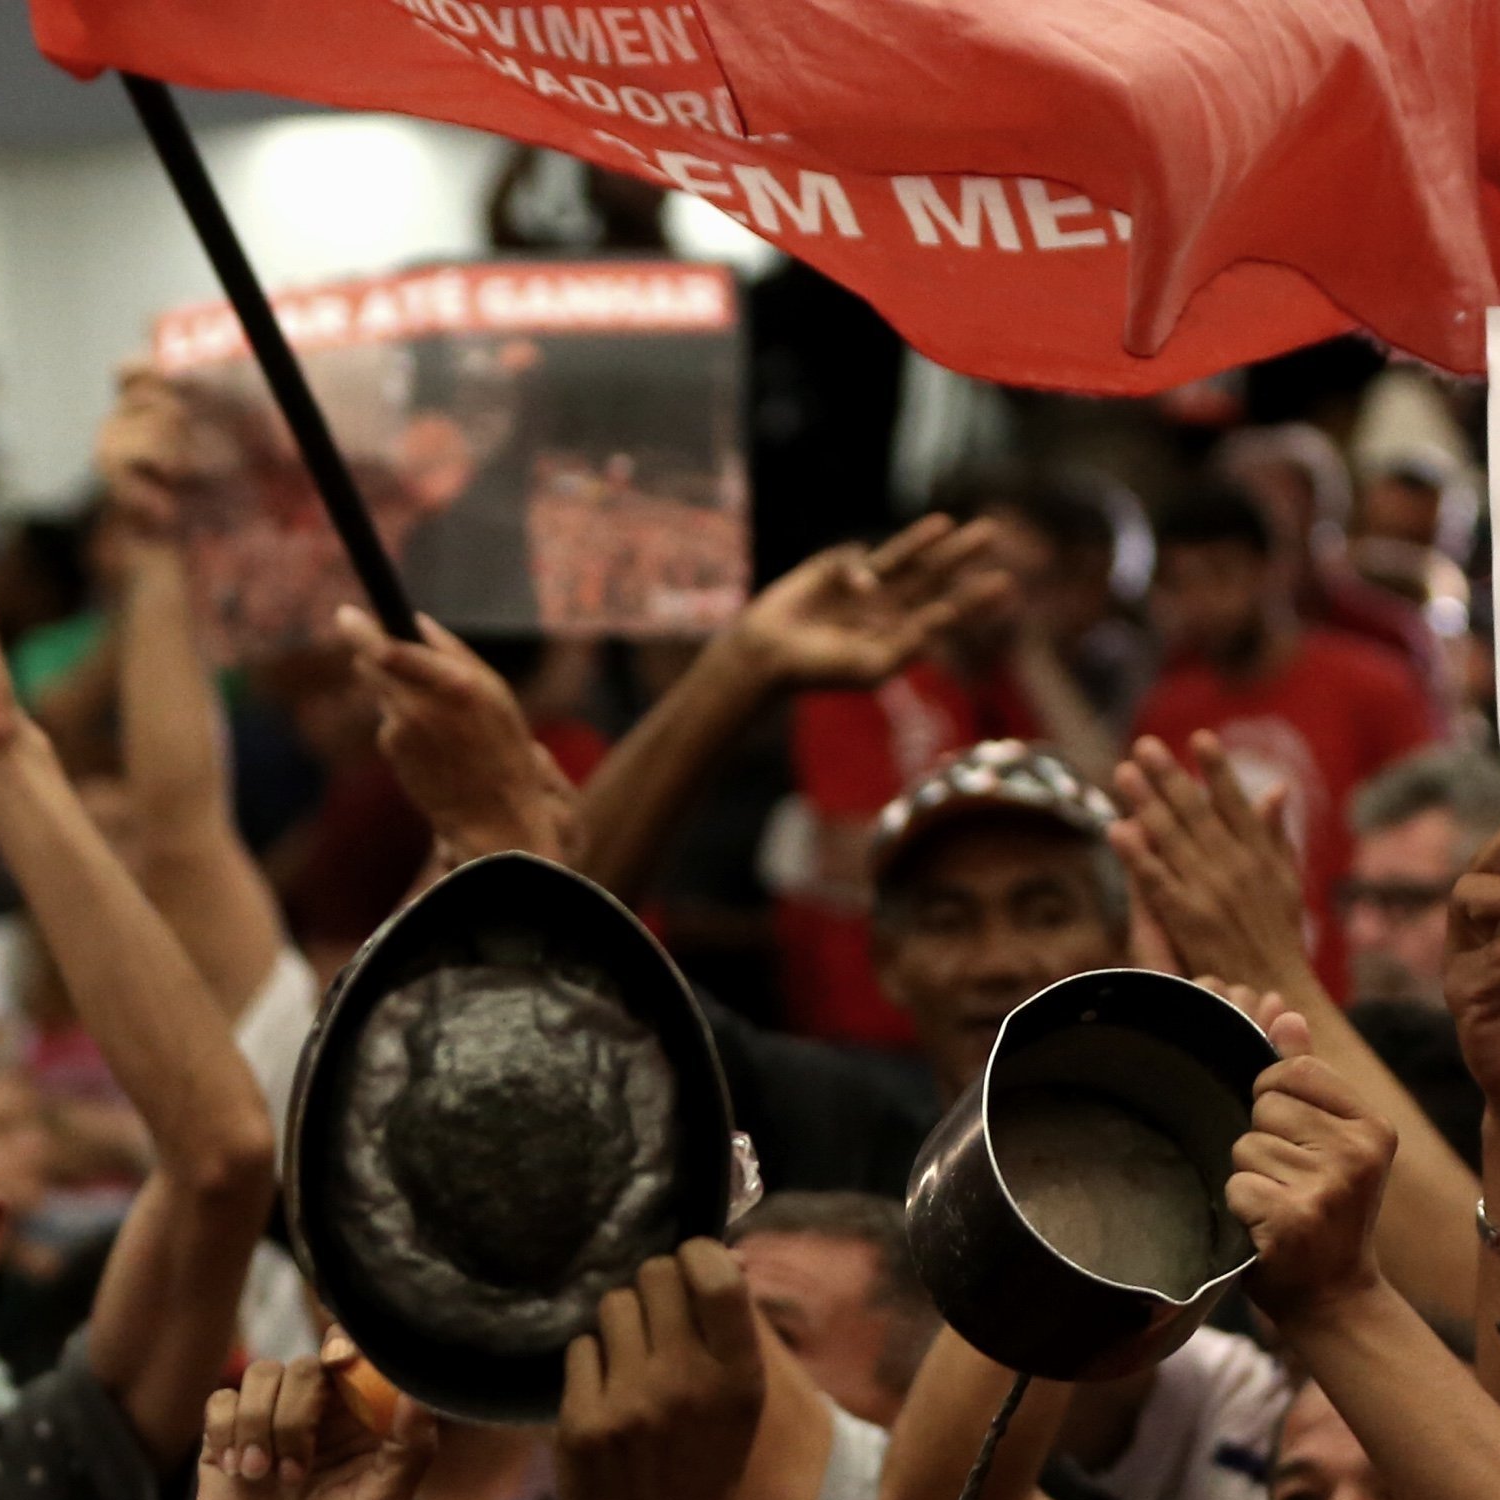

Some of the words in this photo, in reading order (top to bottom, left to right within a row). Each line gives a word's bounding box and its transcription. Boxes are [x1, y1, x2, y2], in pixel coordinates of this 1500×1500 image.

[400, 0, 697, 66] OVIMEN
[593, 130, 862, 238] EM
[891, 174, 1132, 252] ME
